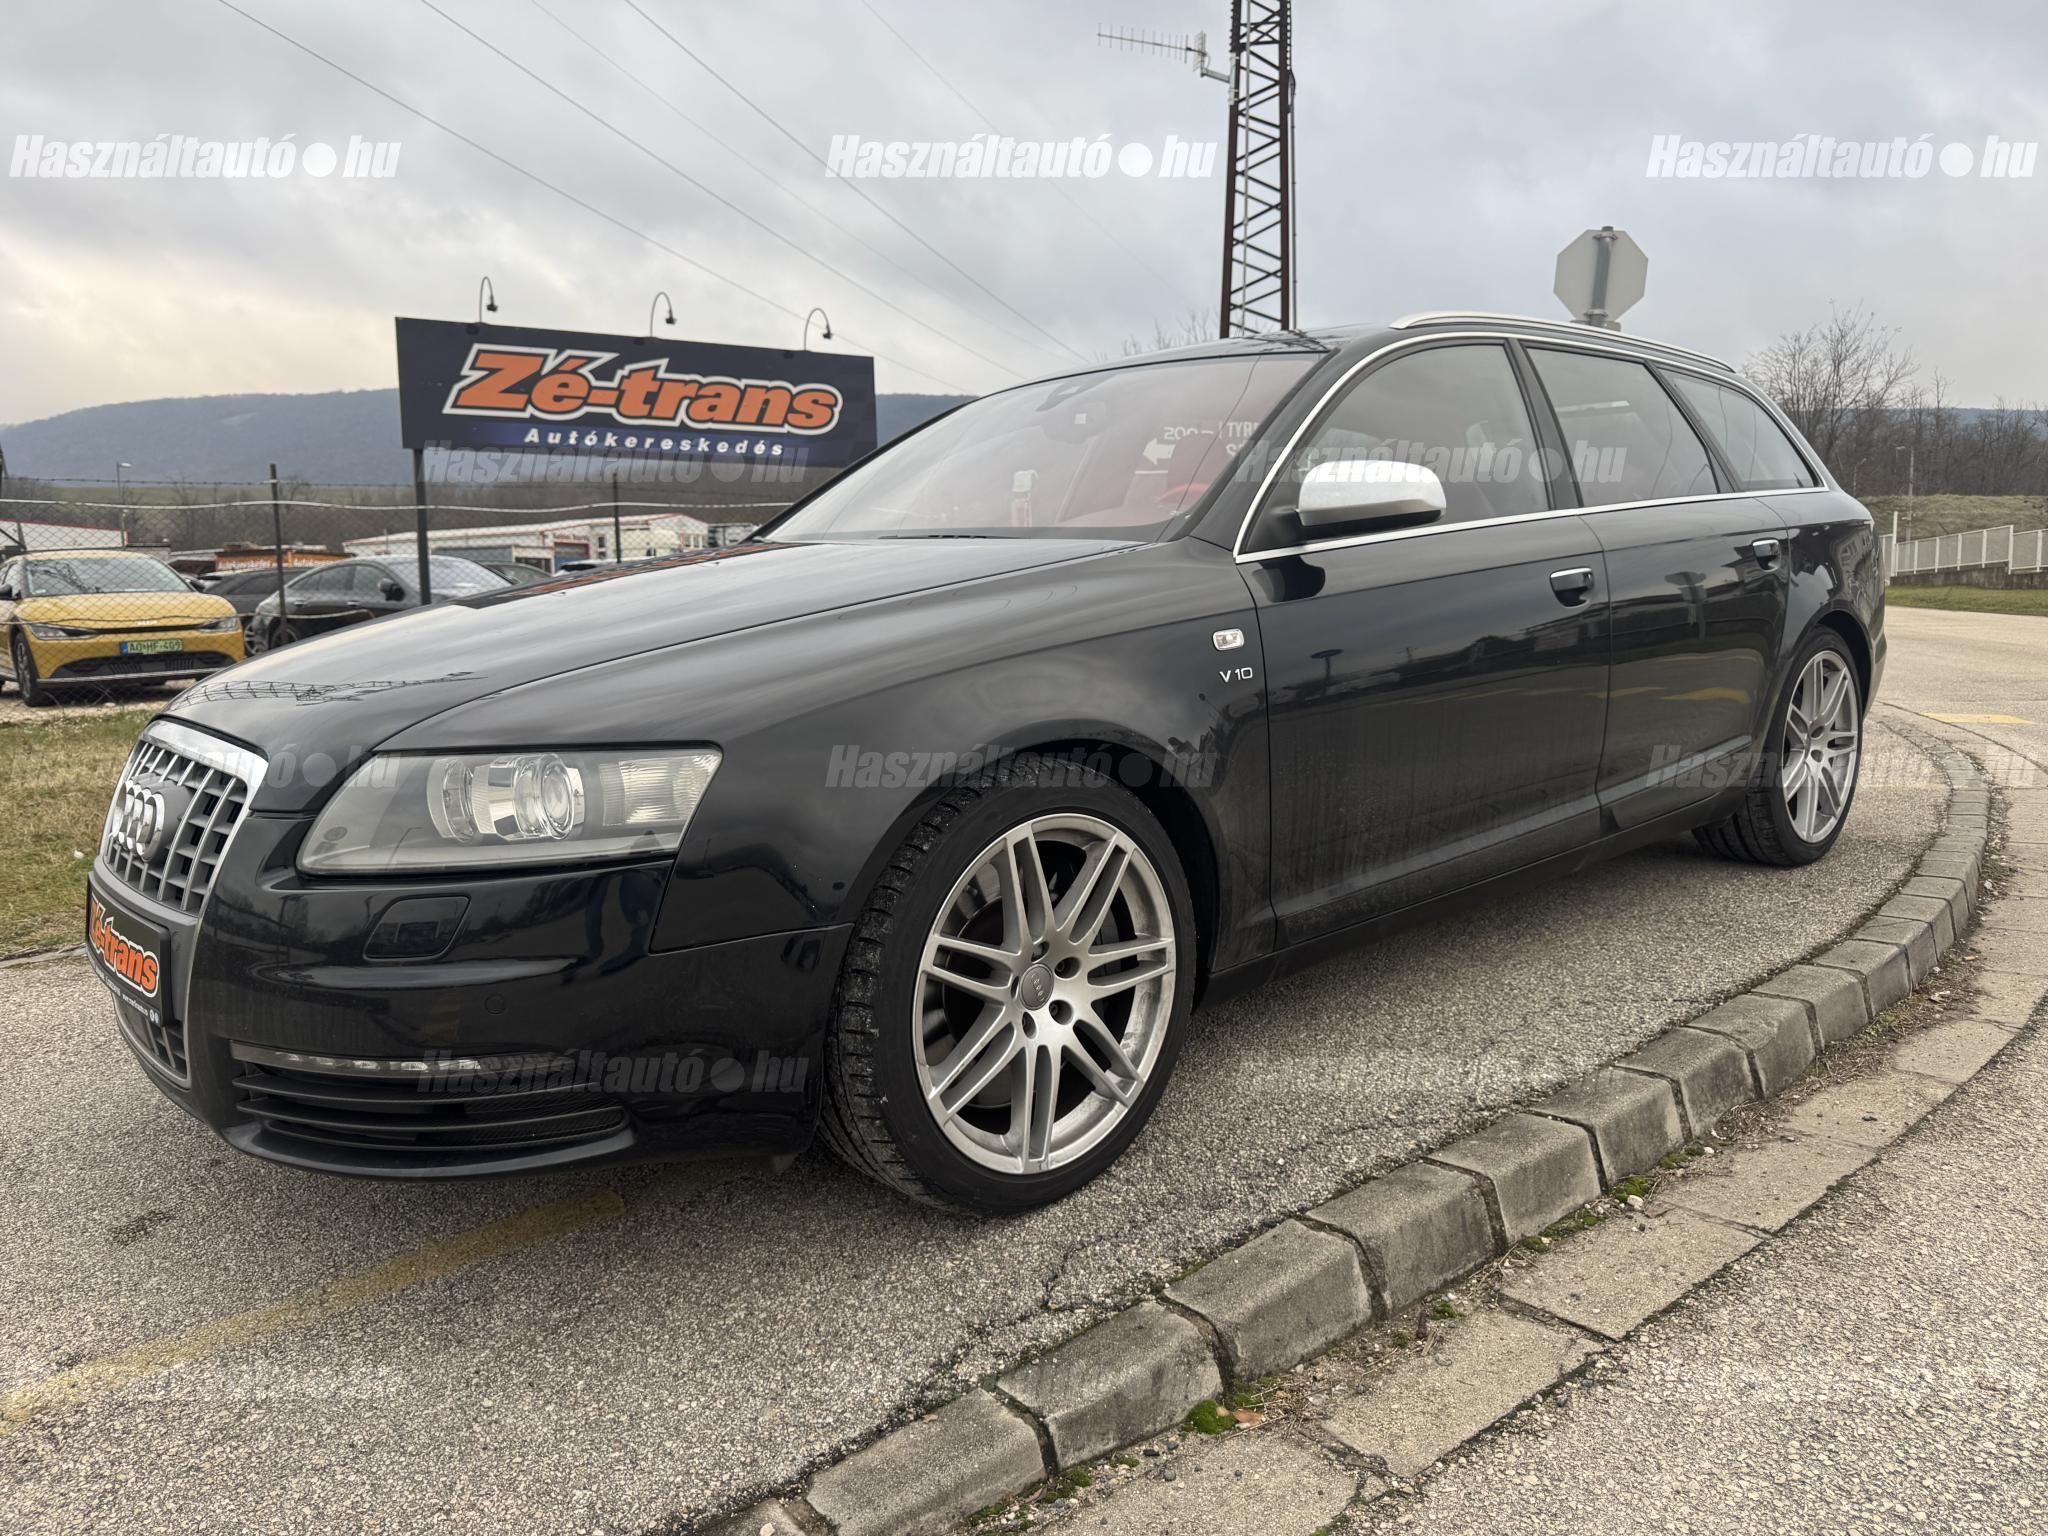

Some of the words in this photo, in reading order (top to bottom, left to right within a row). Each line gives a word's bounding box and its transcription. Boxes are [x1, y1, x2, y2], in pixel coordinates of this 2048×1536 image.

[443, 344, 843, 434] Zé-trans
[524, 428, 784, 456] Autókereskedés
[1227, 421, 1259, 438] TYR
